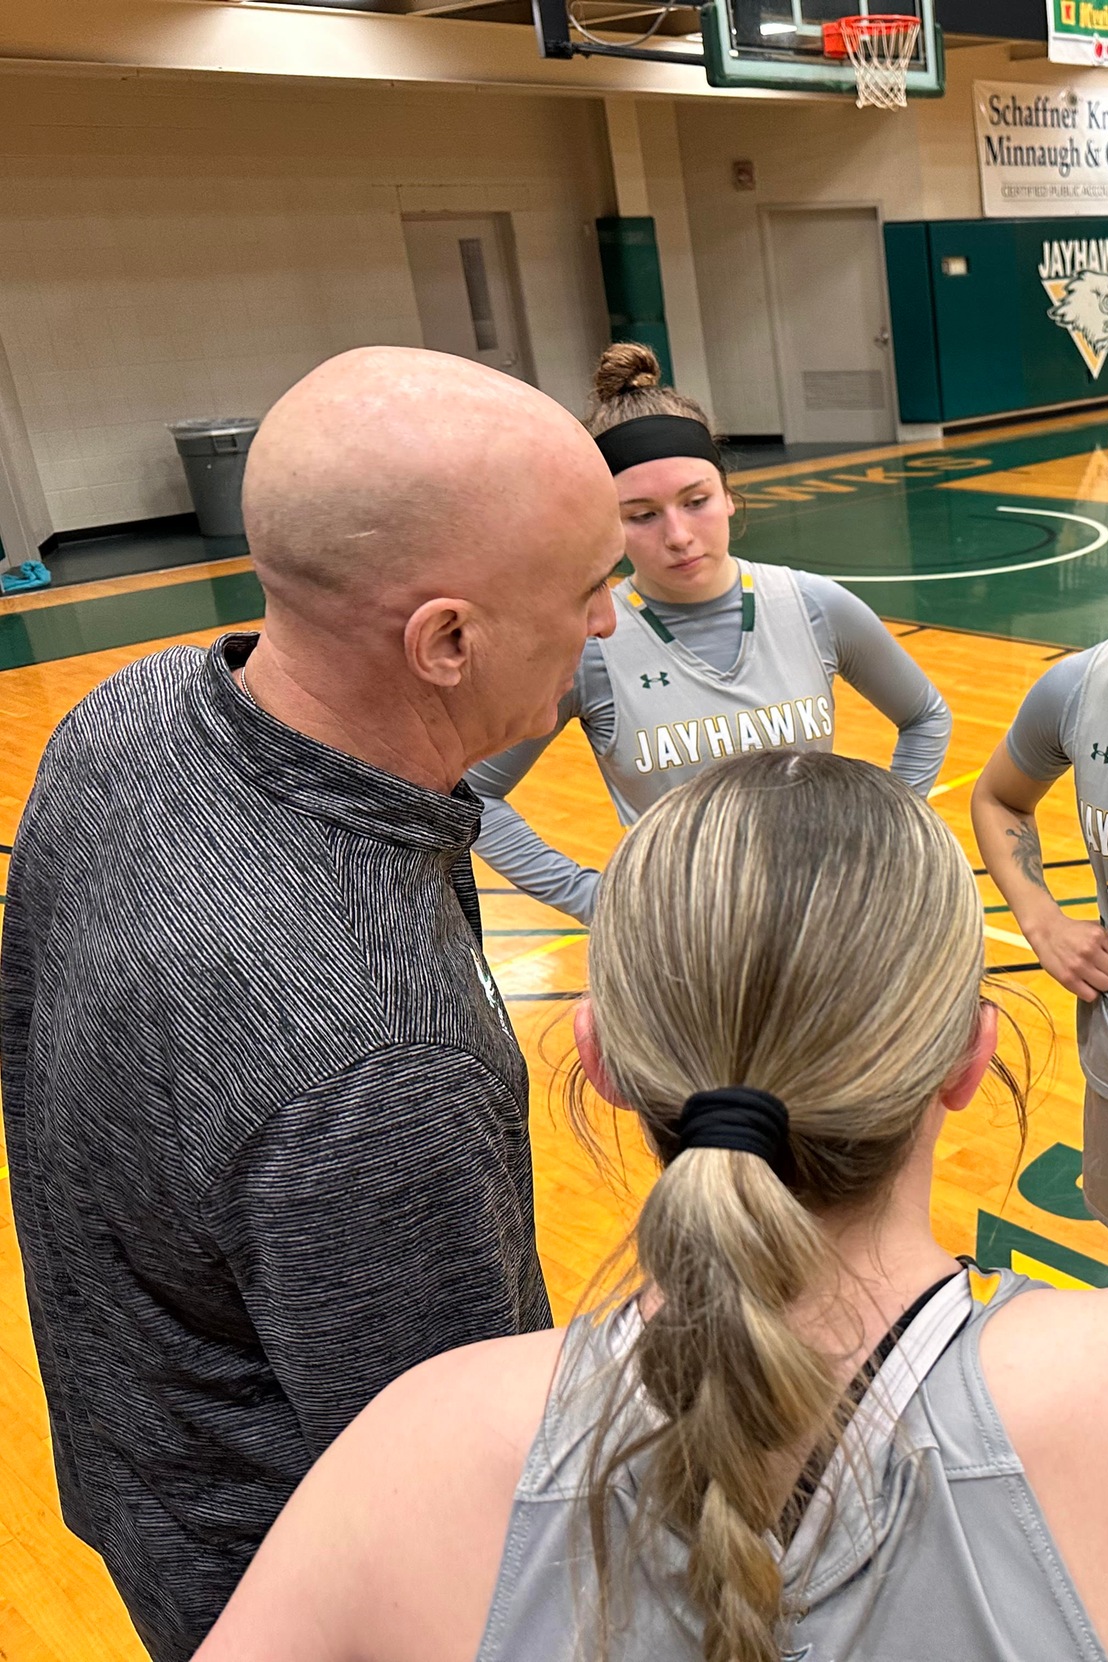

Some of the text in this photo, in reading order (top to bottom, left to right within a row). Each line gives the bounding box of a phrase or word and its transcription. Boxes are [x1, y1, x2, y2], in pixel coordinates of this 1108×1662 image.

[988, 95, 1078, 129] Schaffner
[984, 135, 1081, 178] Minnaugh
[1084, 140, 1102, 168] &
[634, 695, 833, 774] JAYHAWKS
